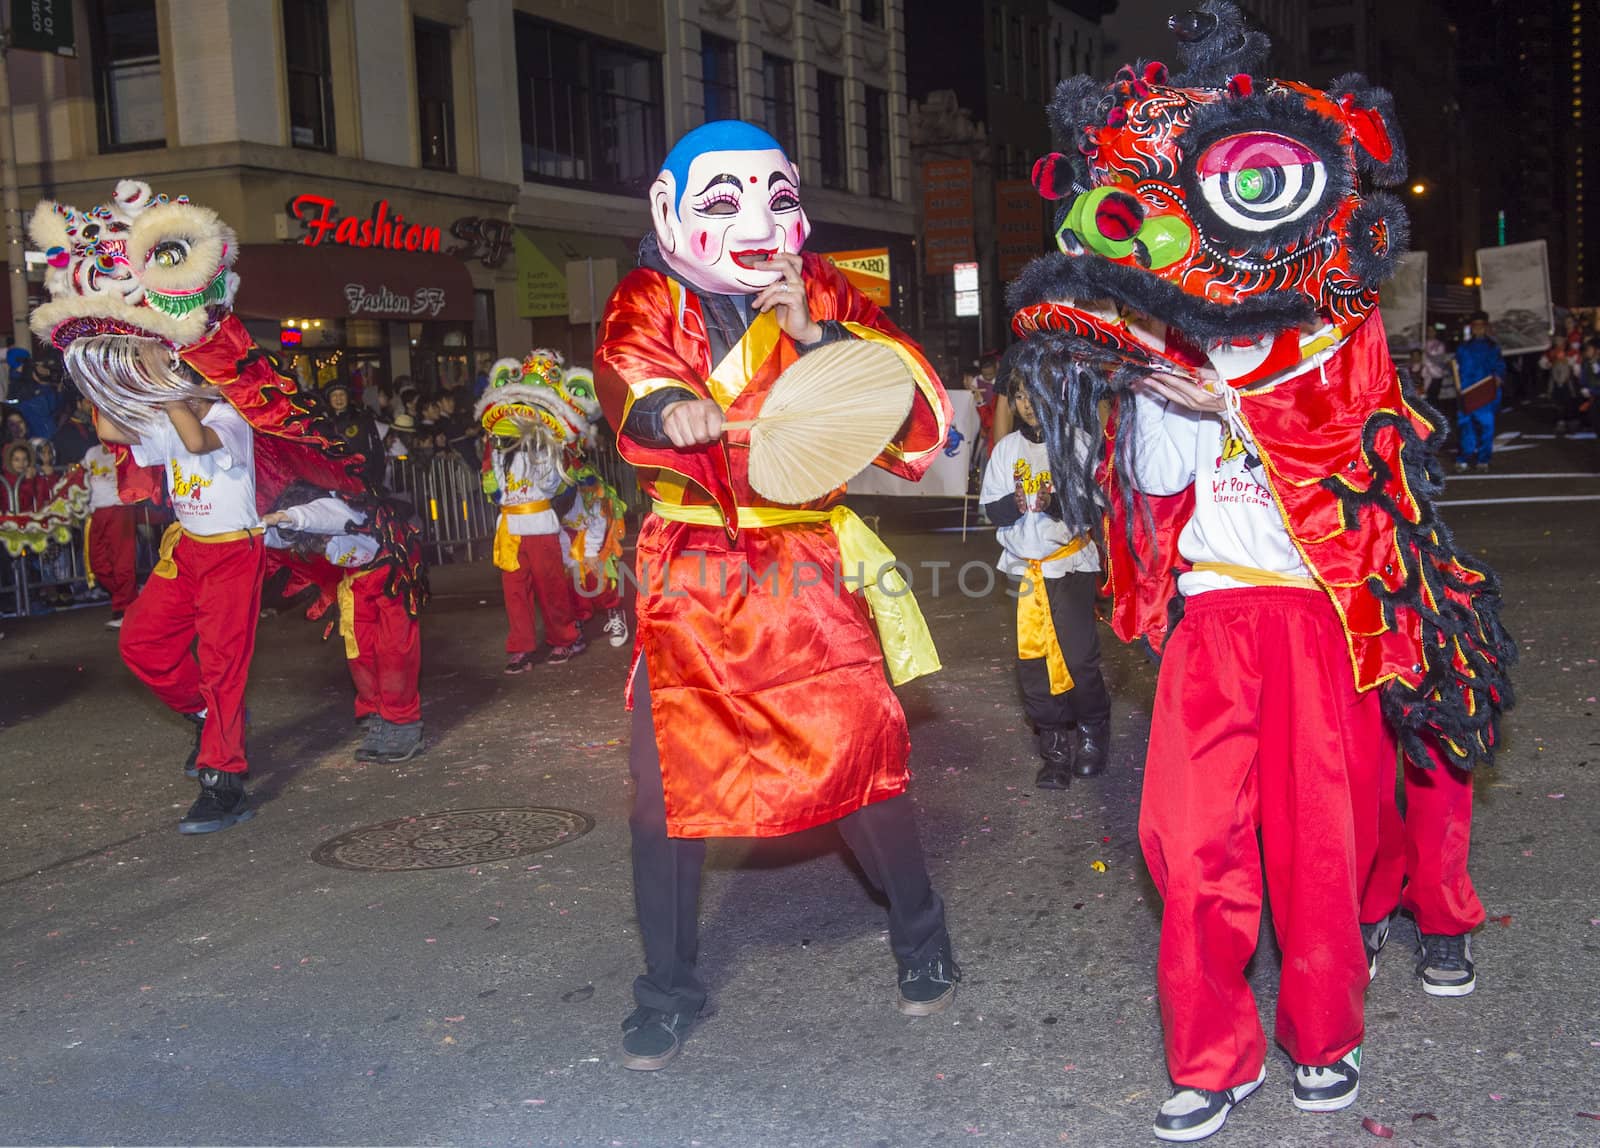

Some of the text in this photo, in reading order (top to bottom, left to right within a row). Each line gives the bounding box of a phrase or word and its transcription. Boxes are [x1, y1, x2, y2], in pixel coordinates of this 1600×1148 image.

[292, 194, 441, 253] Fashion
[345, 284, 446, 316] Fashion SF
